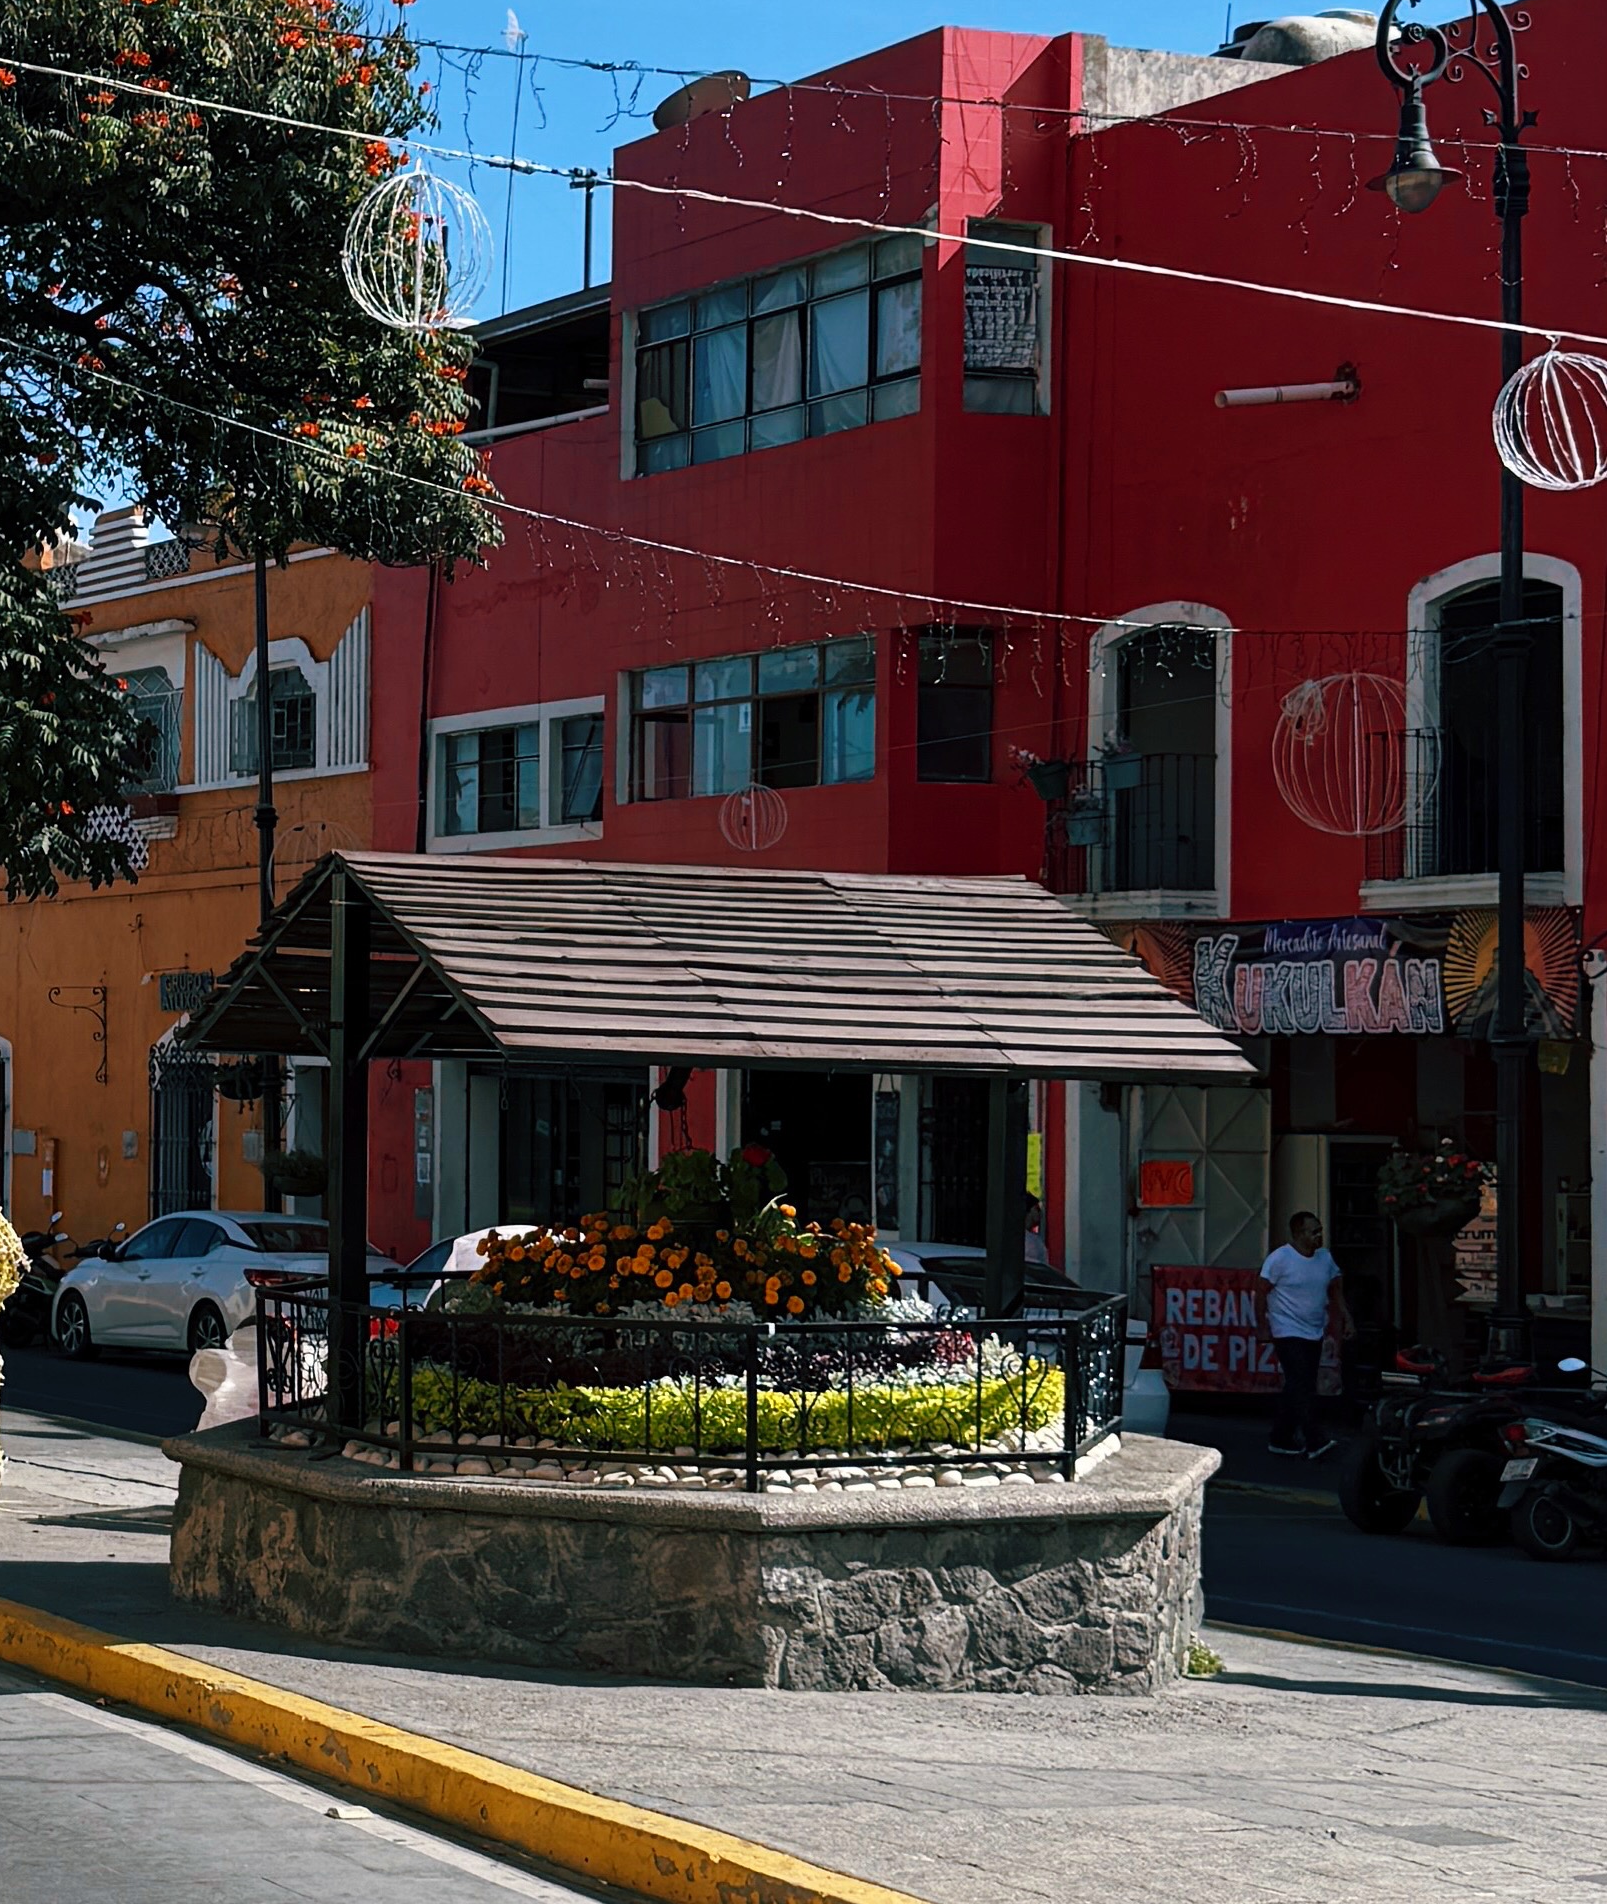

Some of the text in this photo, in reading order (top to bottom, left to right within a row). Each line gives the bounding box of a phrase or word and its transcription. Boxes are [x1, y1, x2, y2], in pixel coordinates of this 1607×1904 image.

[1327, 922, 1388, 952] Artesanal
[165, 974, 201, 992] GRUPO
[1194, 933, 1444, 1034] KUKULKÁN
[1166, 1288, 1259, 1327] REBAN
[1182, 1333, 1278, 1375] DE PIZ
